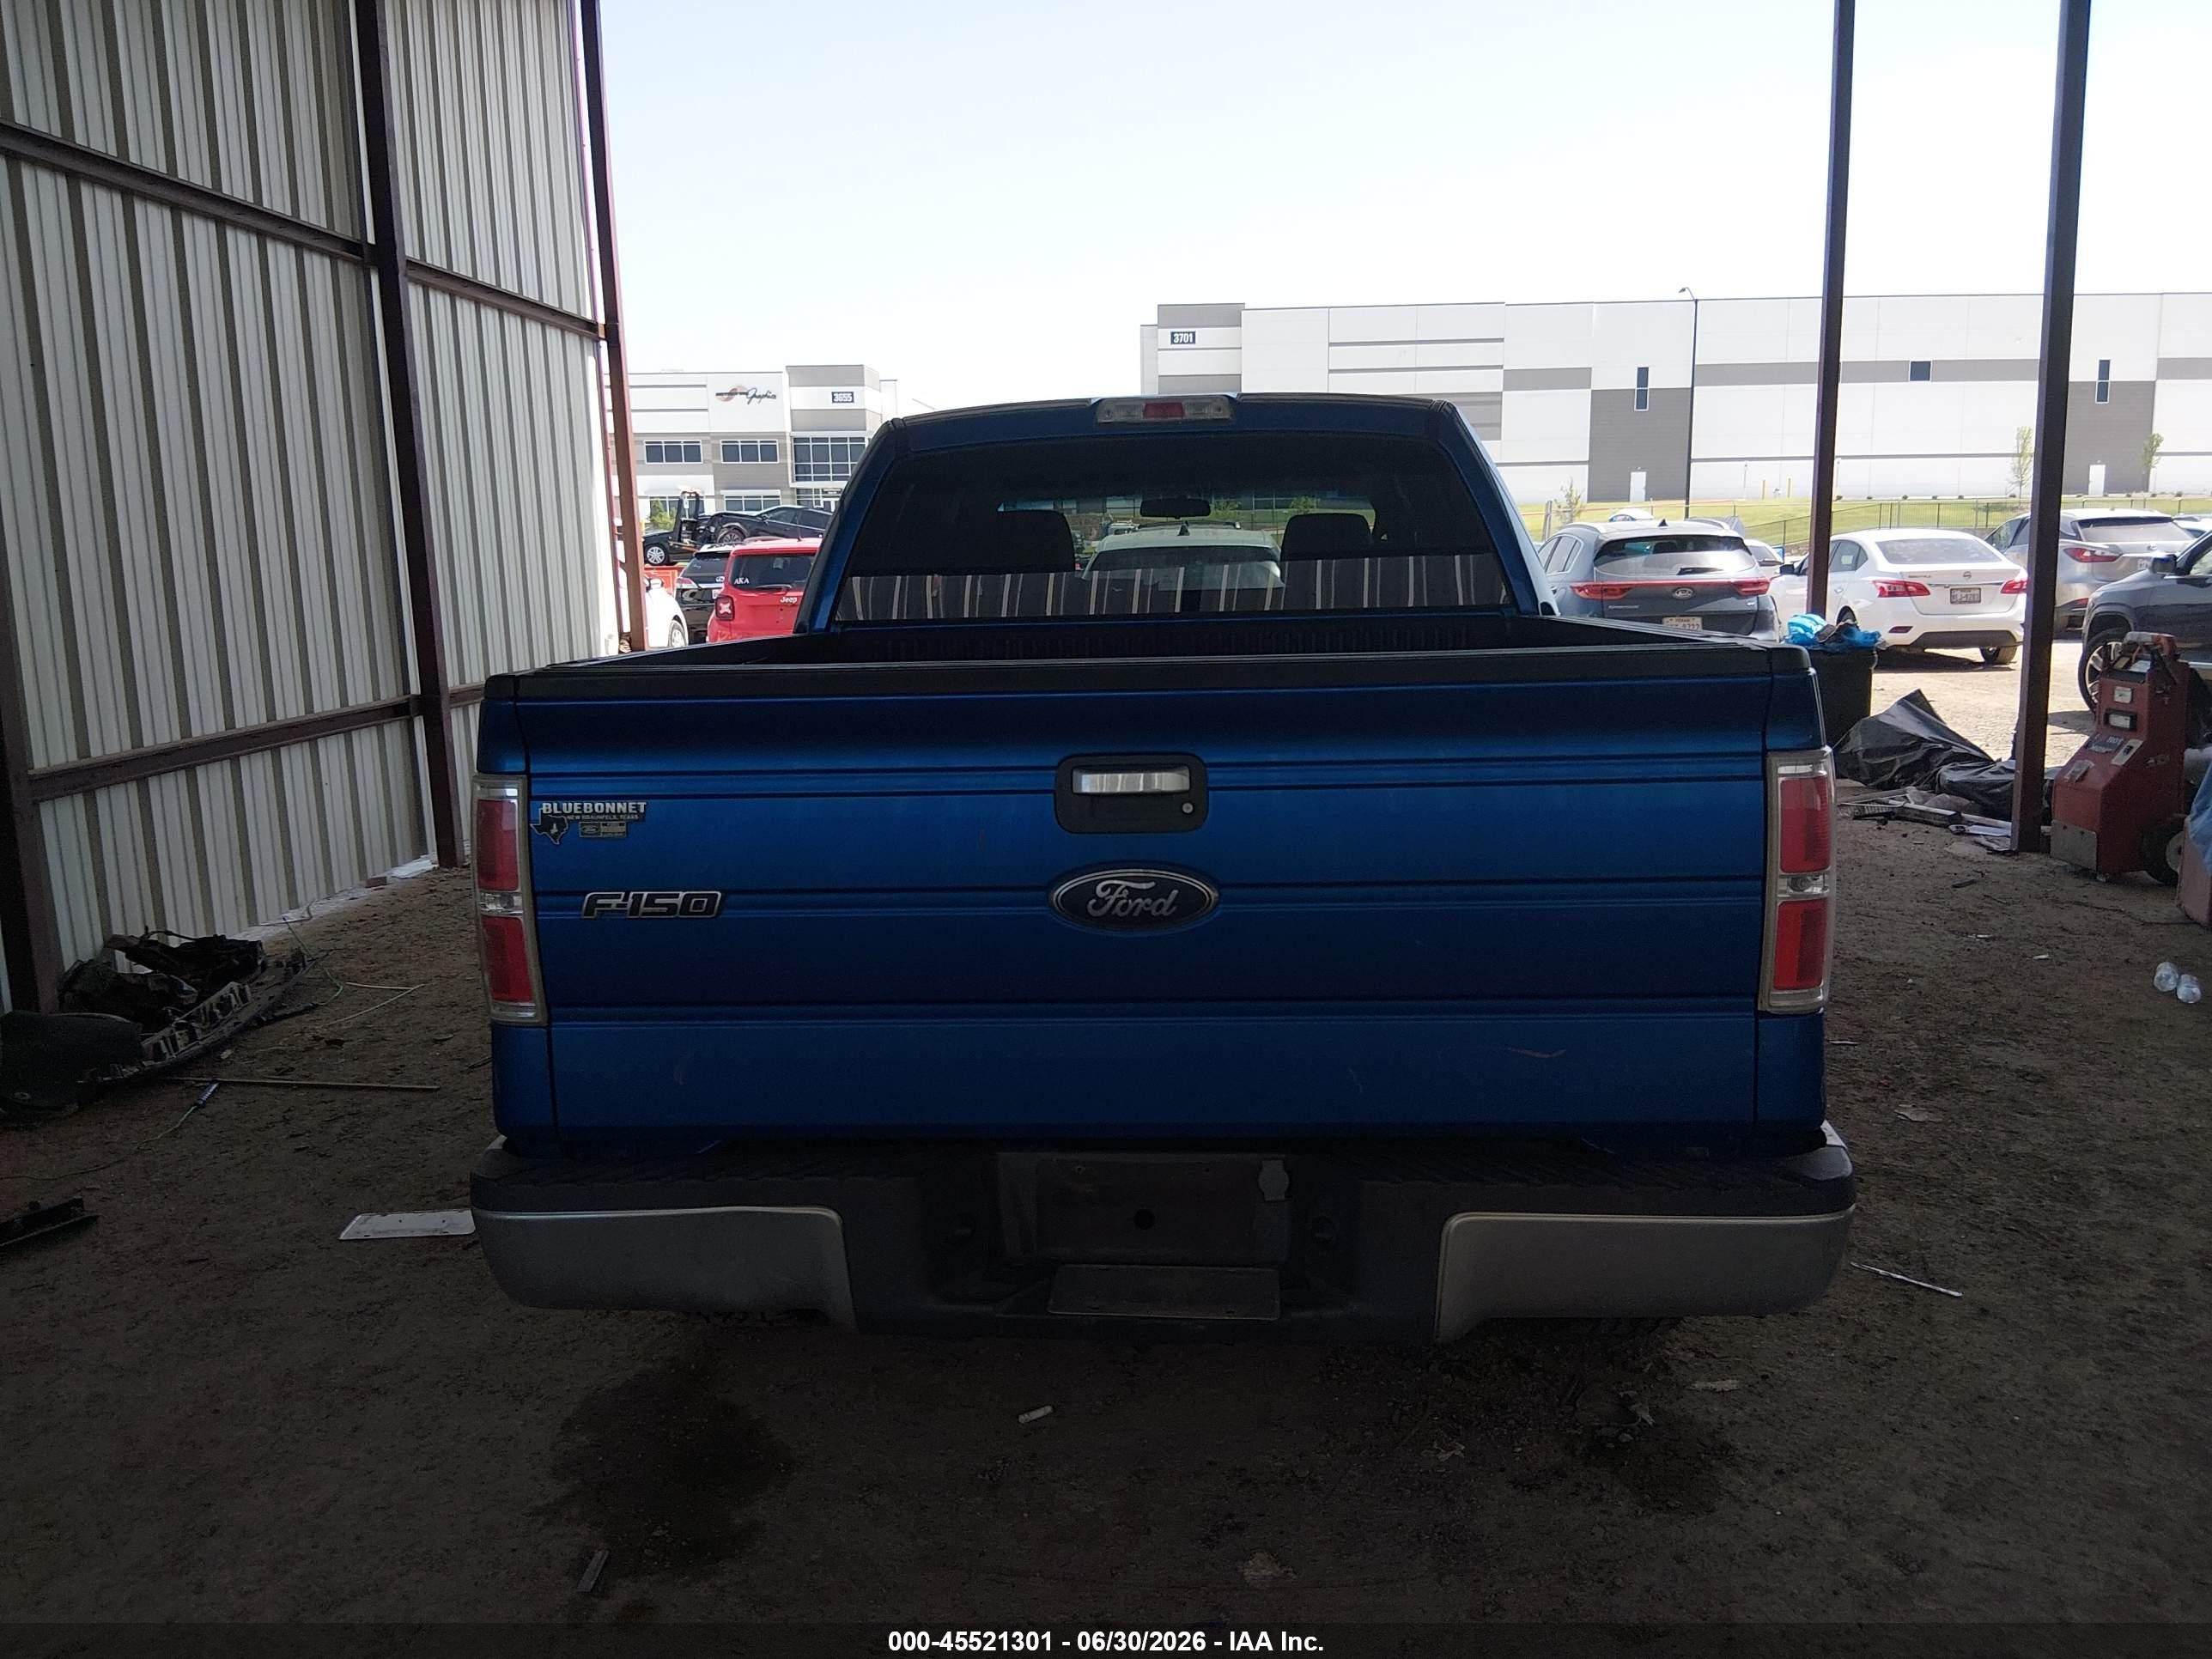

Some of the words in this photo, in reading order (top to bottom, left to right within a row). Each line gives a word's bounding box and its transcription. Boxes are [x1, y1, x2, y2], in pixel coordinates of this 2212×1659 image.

[1173, 332, 1194, 343] 3701
[542, 802, 647, 814] BLUEBONNET
[581, 890, 722, 919] F-150
[1086, 879, 1179, 917] Ford
